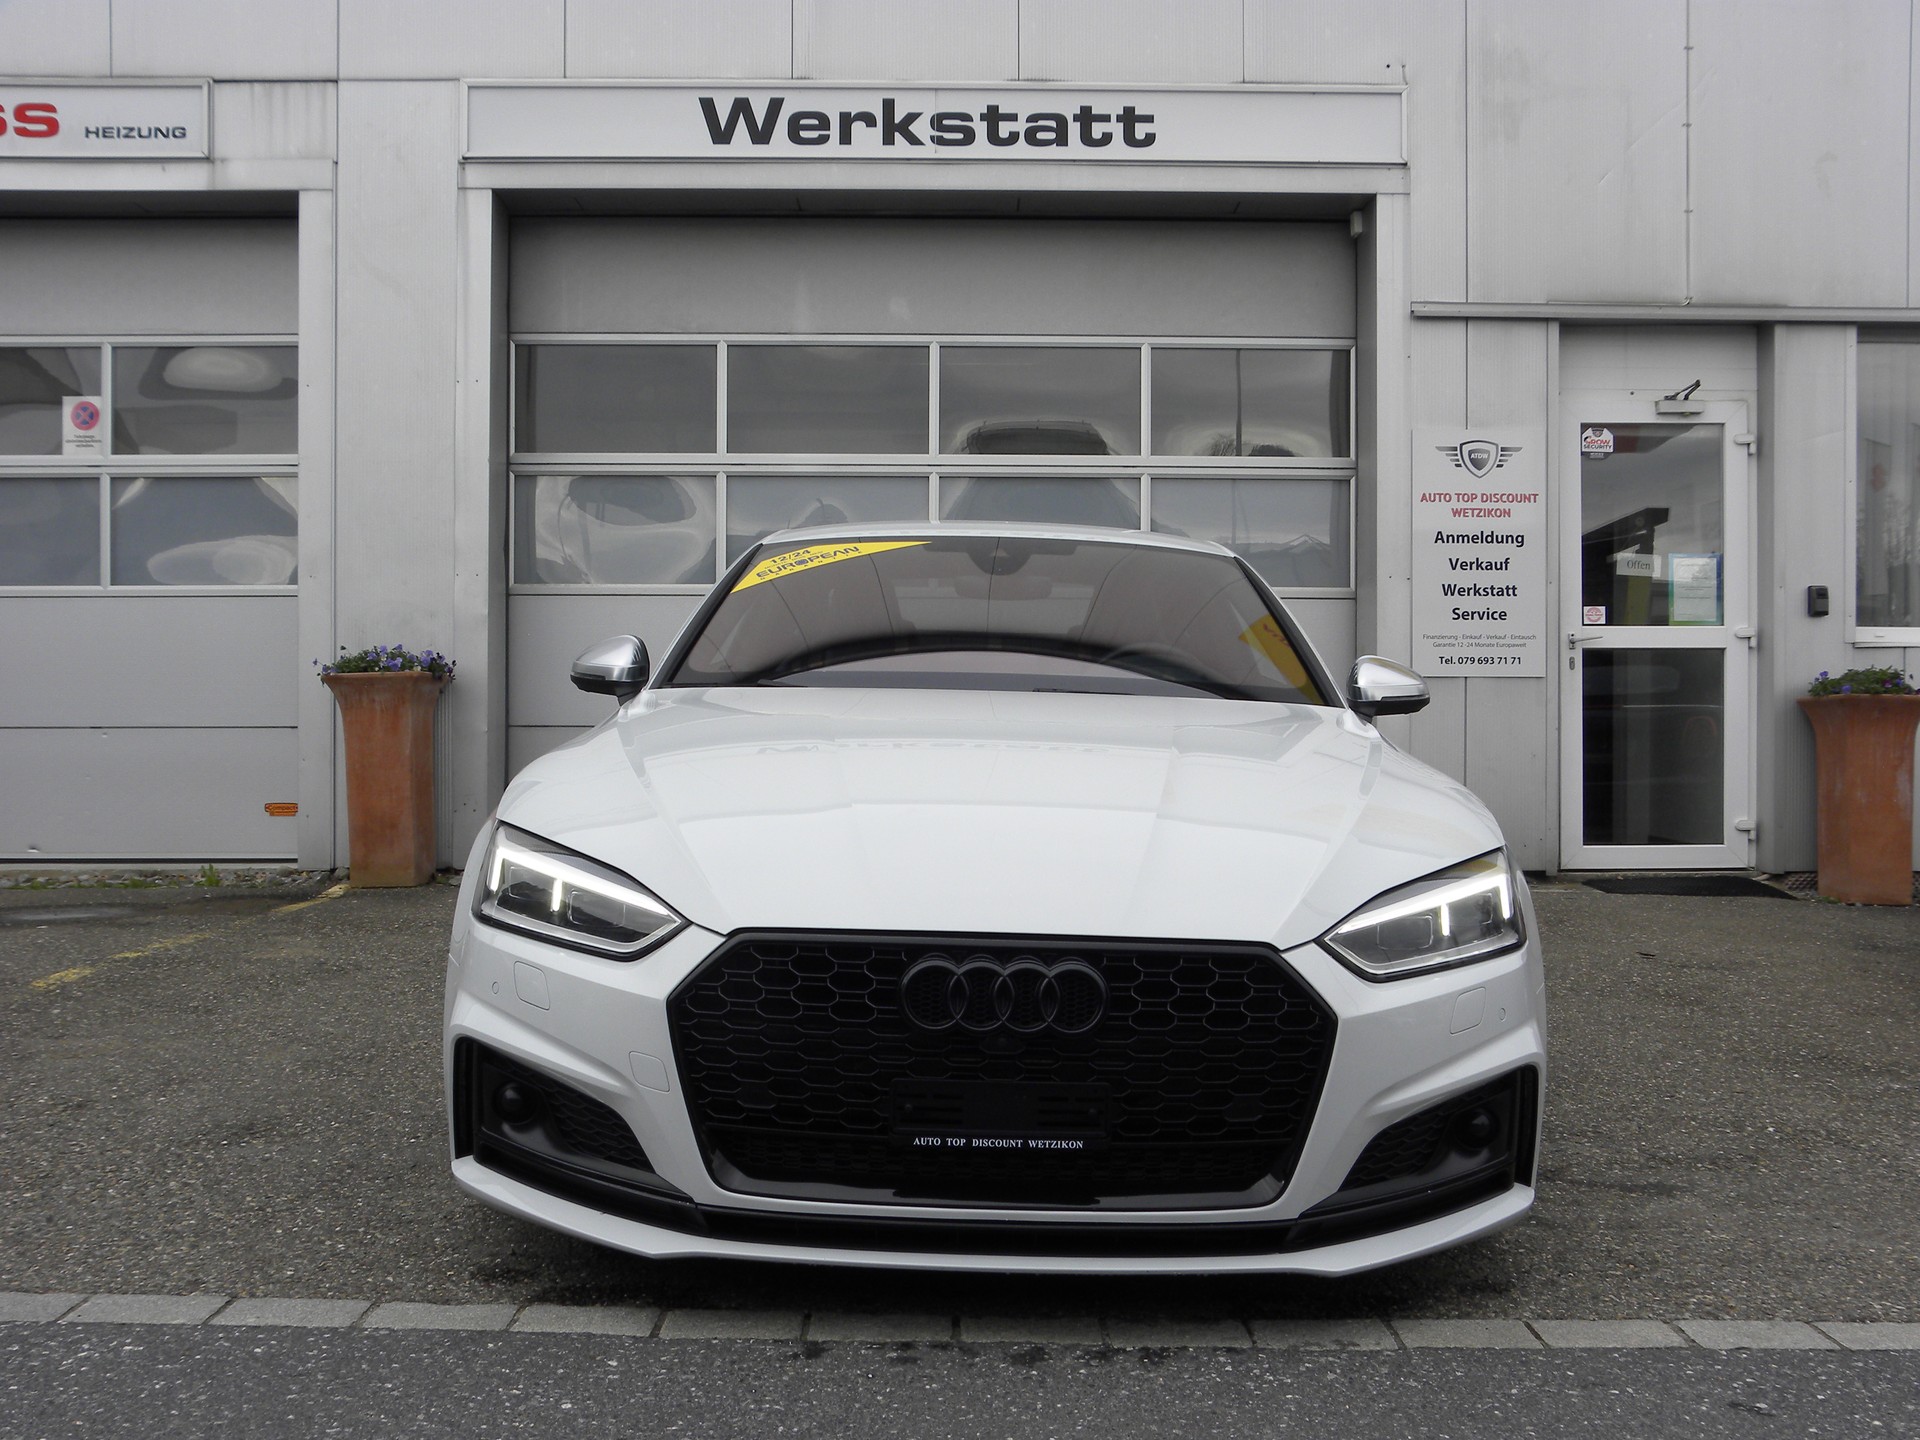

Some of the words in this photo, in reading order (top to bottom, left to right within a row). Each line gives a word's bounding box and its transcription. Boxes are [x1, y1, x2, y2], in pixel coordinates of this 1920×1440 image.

[0, 102, 60, 138] S
[84, 126, 187, 139] HEIZUNG
[698, 97, 1156, 148] Werkstatt
[1420, 492, 1452, 503] AUTO
[1455, 493, 1478, 503] TOP
[1481, 493, 1539, 503] DISCOUNT
[1451, 508, 1511, 518] WETZIKON
[1434, 530, 1525, 548] Anmeldung
[756, 546, 860, 578] EUROPEAN
[771, 549, 811, 564] 12/24
[1448, 557, 1510, 571] Verkauf
[1626, 560, 1651, 570] Offen
[1442, 583, 1518, 597] Werkstatt
[1452, 607, 1507, 620] Service
[1439, 656, 1456, 665] Tel.
[1458, 657, 1476, 665] 079
[1477, 657, 1495, 665] 693
[1497, 657, 1508, 665] 71
[1510, 657, 1521, 665] 71
[913, 1137, 941, 1146] AUTO
[946, 1138, 966, 1146] TOP
[972, 1138, 1023, 1148] DISCOUNT
[1028, 1140, 1084, 1149] WETZIKON
